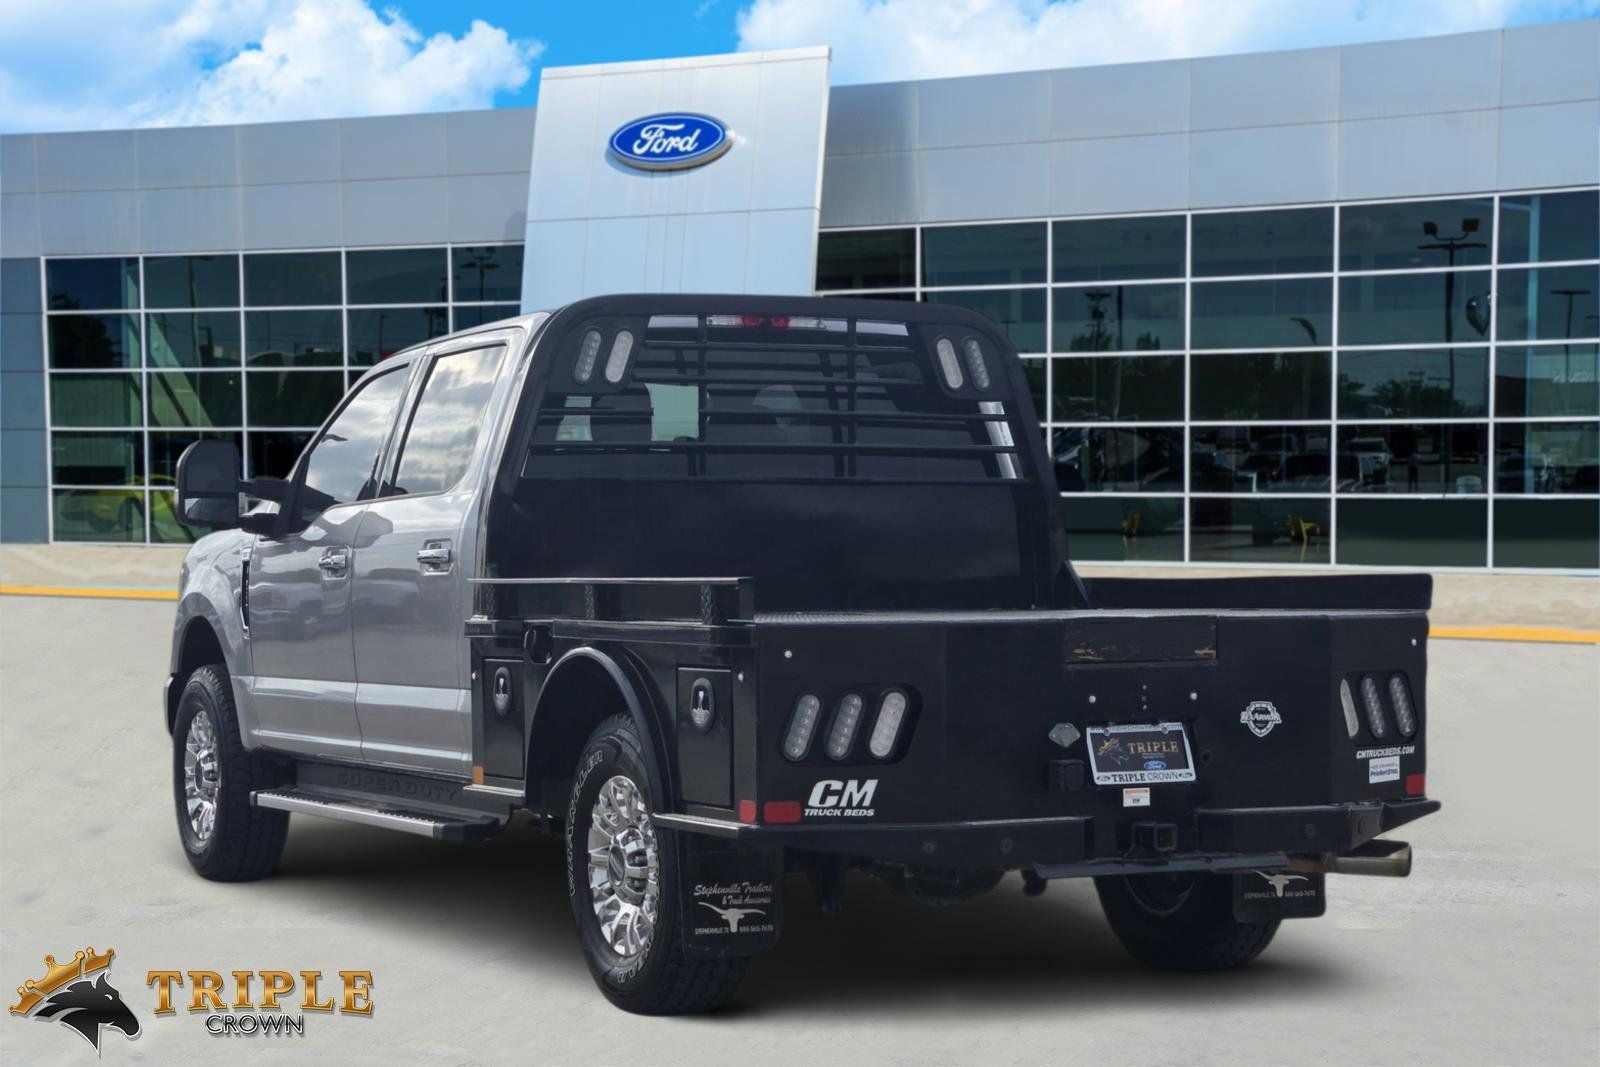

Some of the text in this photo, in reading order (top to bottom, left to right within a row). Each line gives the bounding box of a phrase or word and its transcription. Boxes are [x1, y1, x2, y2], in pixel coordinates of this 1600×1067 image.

[632, 123, 702, 155] Ford
[1127, 741, 1179, 754] TRIPLE
[1111, 772, 1178, 783] TRIPLE CROWN
[807, 778, 879, 808] CM
[804, 808, 875, 817] TRUCK BEDS
